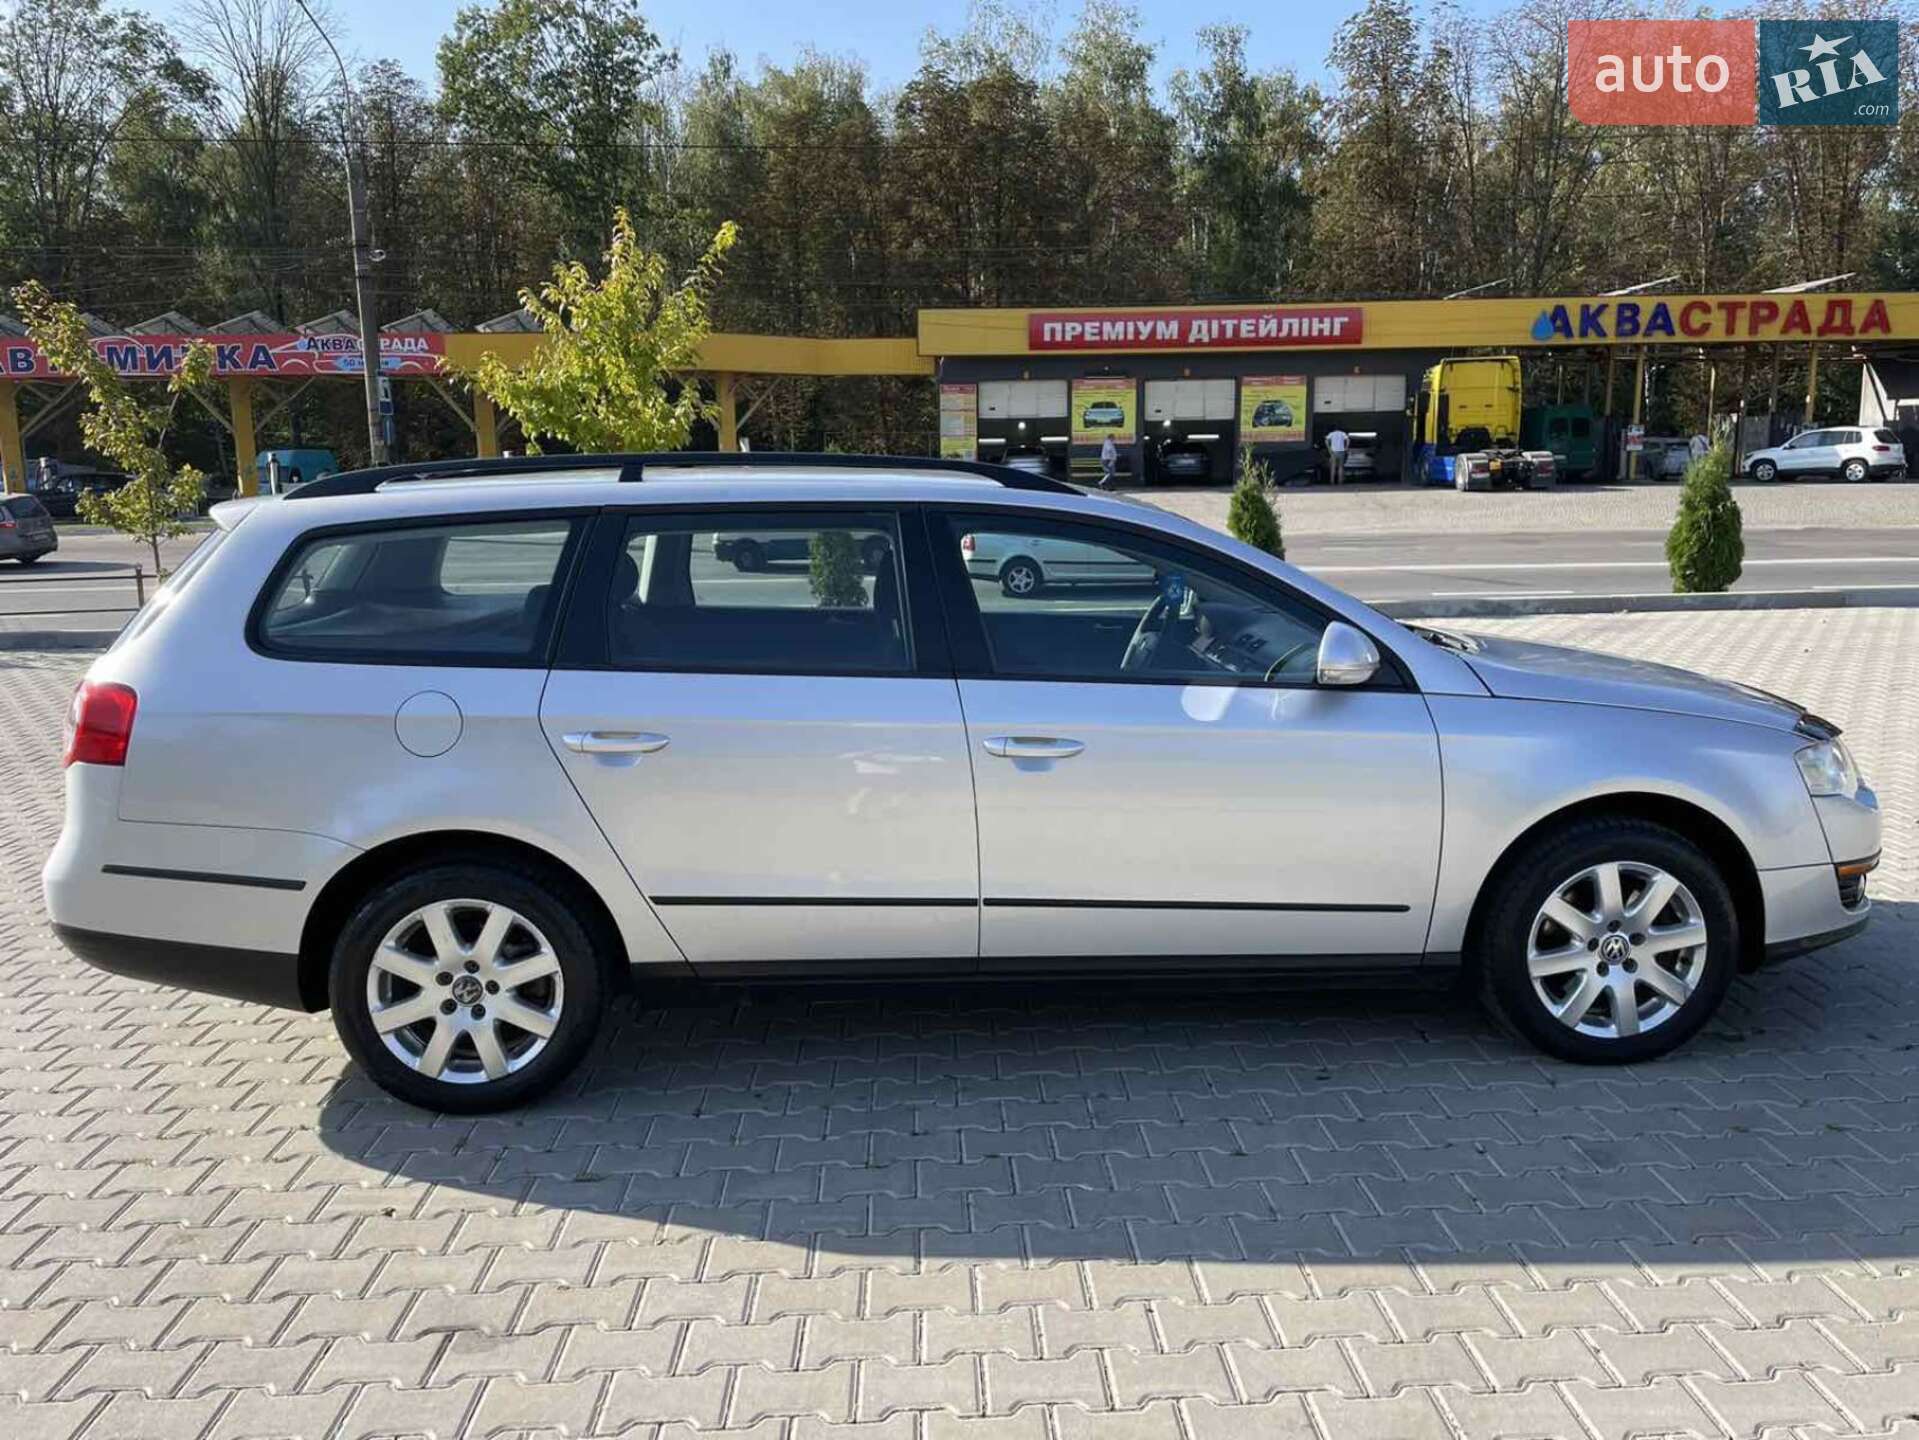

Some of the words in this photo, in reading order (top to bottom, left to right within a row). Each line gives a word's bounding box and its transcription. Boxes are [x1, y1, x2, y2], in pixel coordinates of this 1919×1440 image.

[1043, 320, 1180, 343] ПРЕМІУМ
[1188, 314, 1349, 343] ДІТЕЙЛІНГ
[1549, 299, 1892, 339] АКВАСТРАДА
